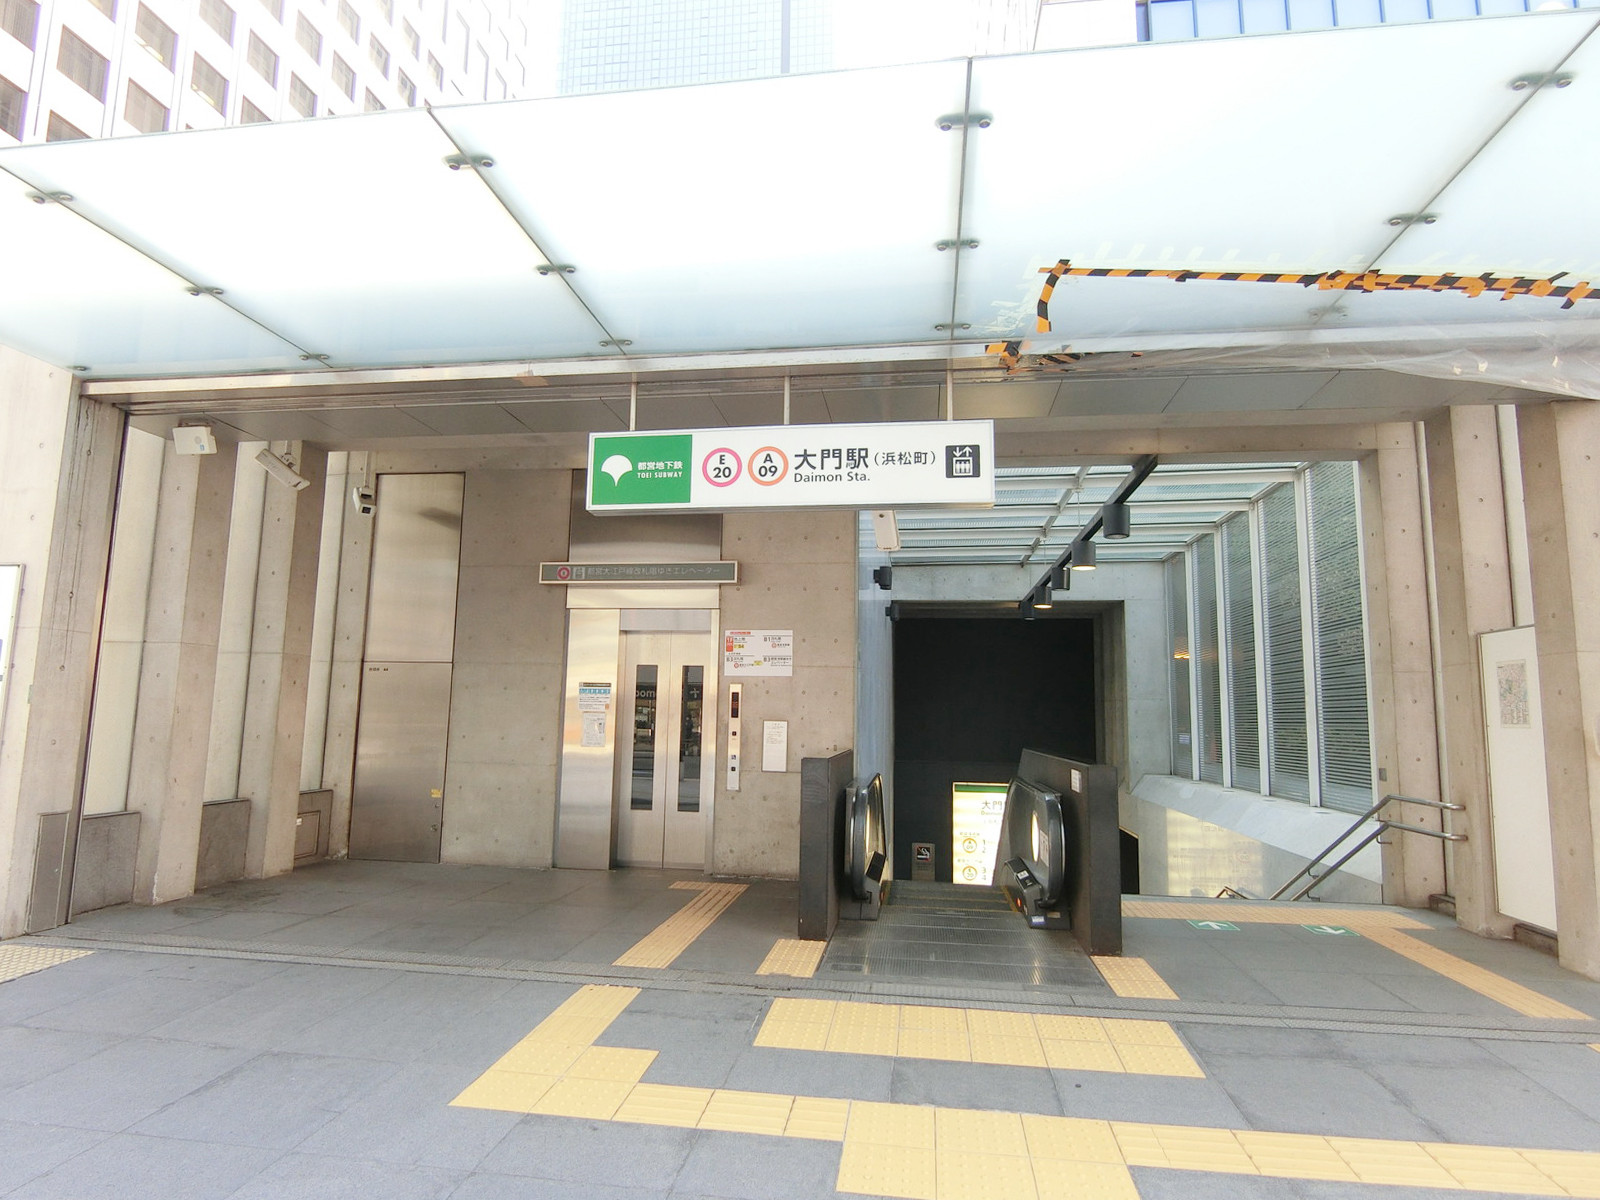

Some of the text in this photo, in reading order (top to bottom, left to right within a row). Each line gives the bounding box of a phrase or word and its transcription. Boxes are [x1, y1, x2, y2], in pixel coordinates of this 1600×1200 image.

[719, 454, 725, 465] E
[763, 453, 773, 464] A
[794, 447, 869, 470] 大門駅
[637, 460, 683, 470] 都営地下鉄
[637, 471, 651, 479] TOEI
[713, 466, 732, 478] 20
[758, 465, 778, 477] 09
[794, 471, 871, 483] Daimon Sta.
